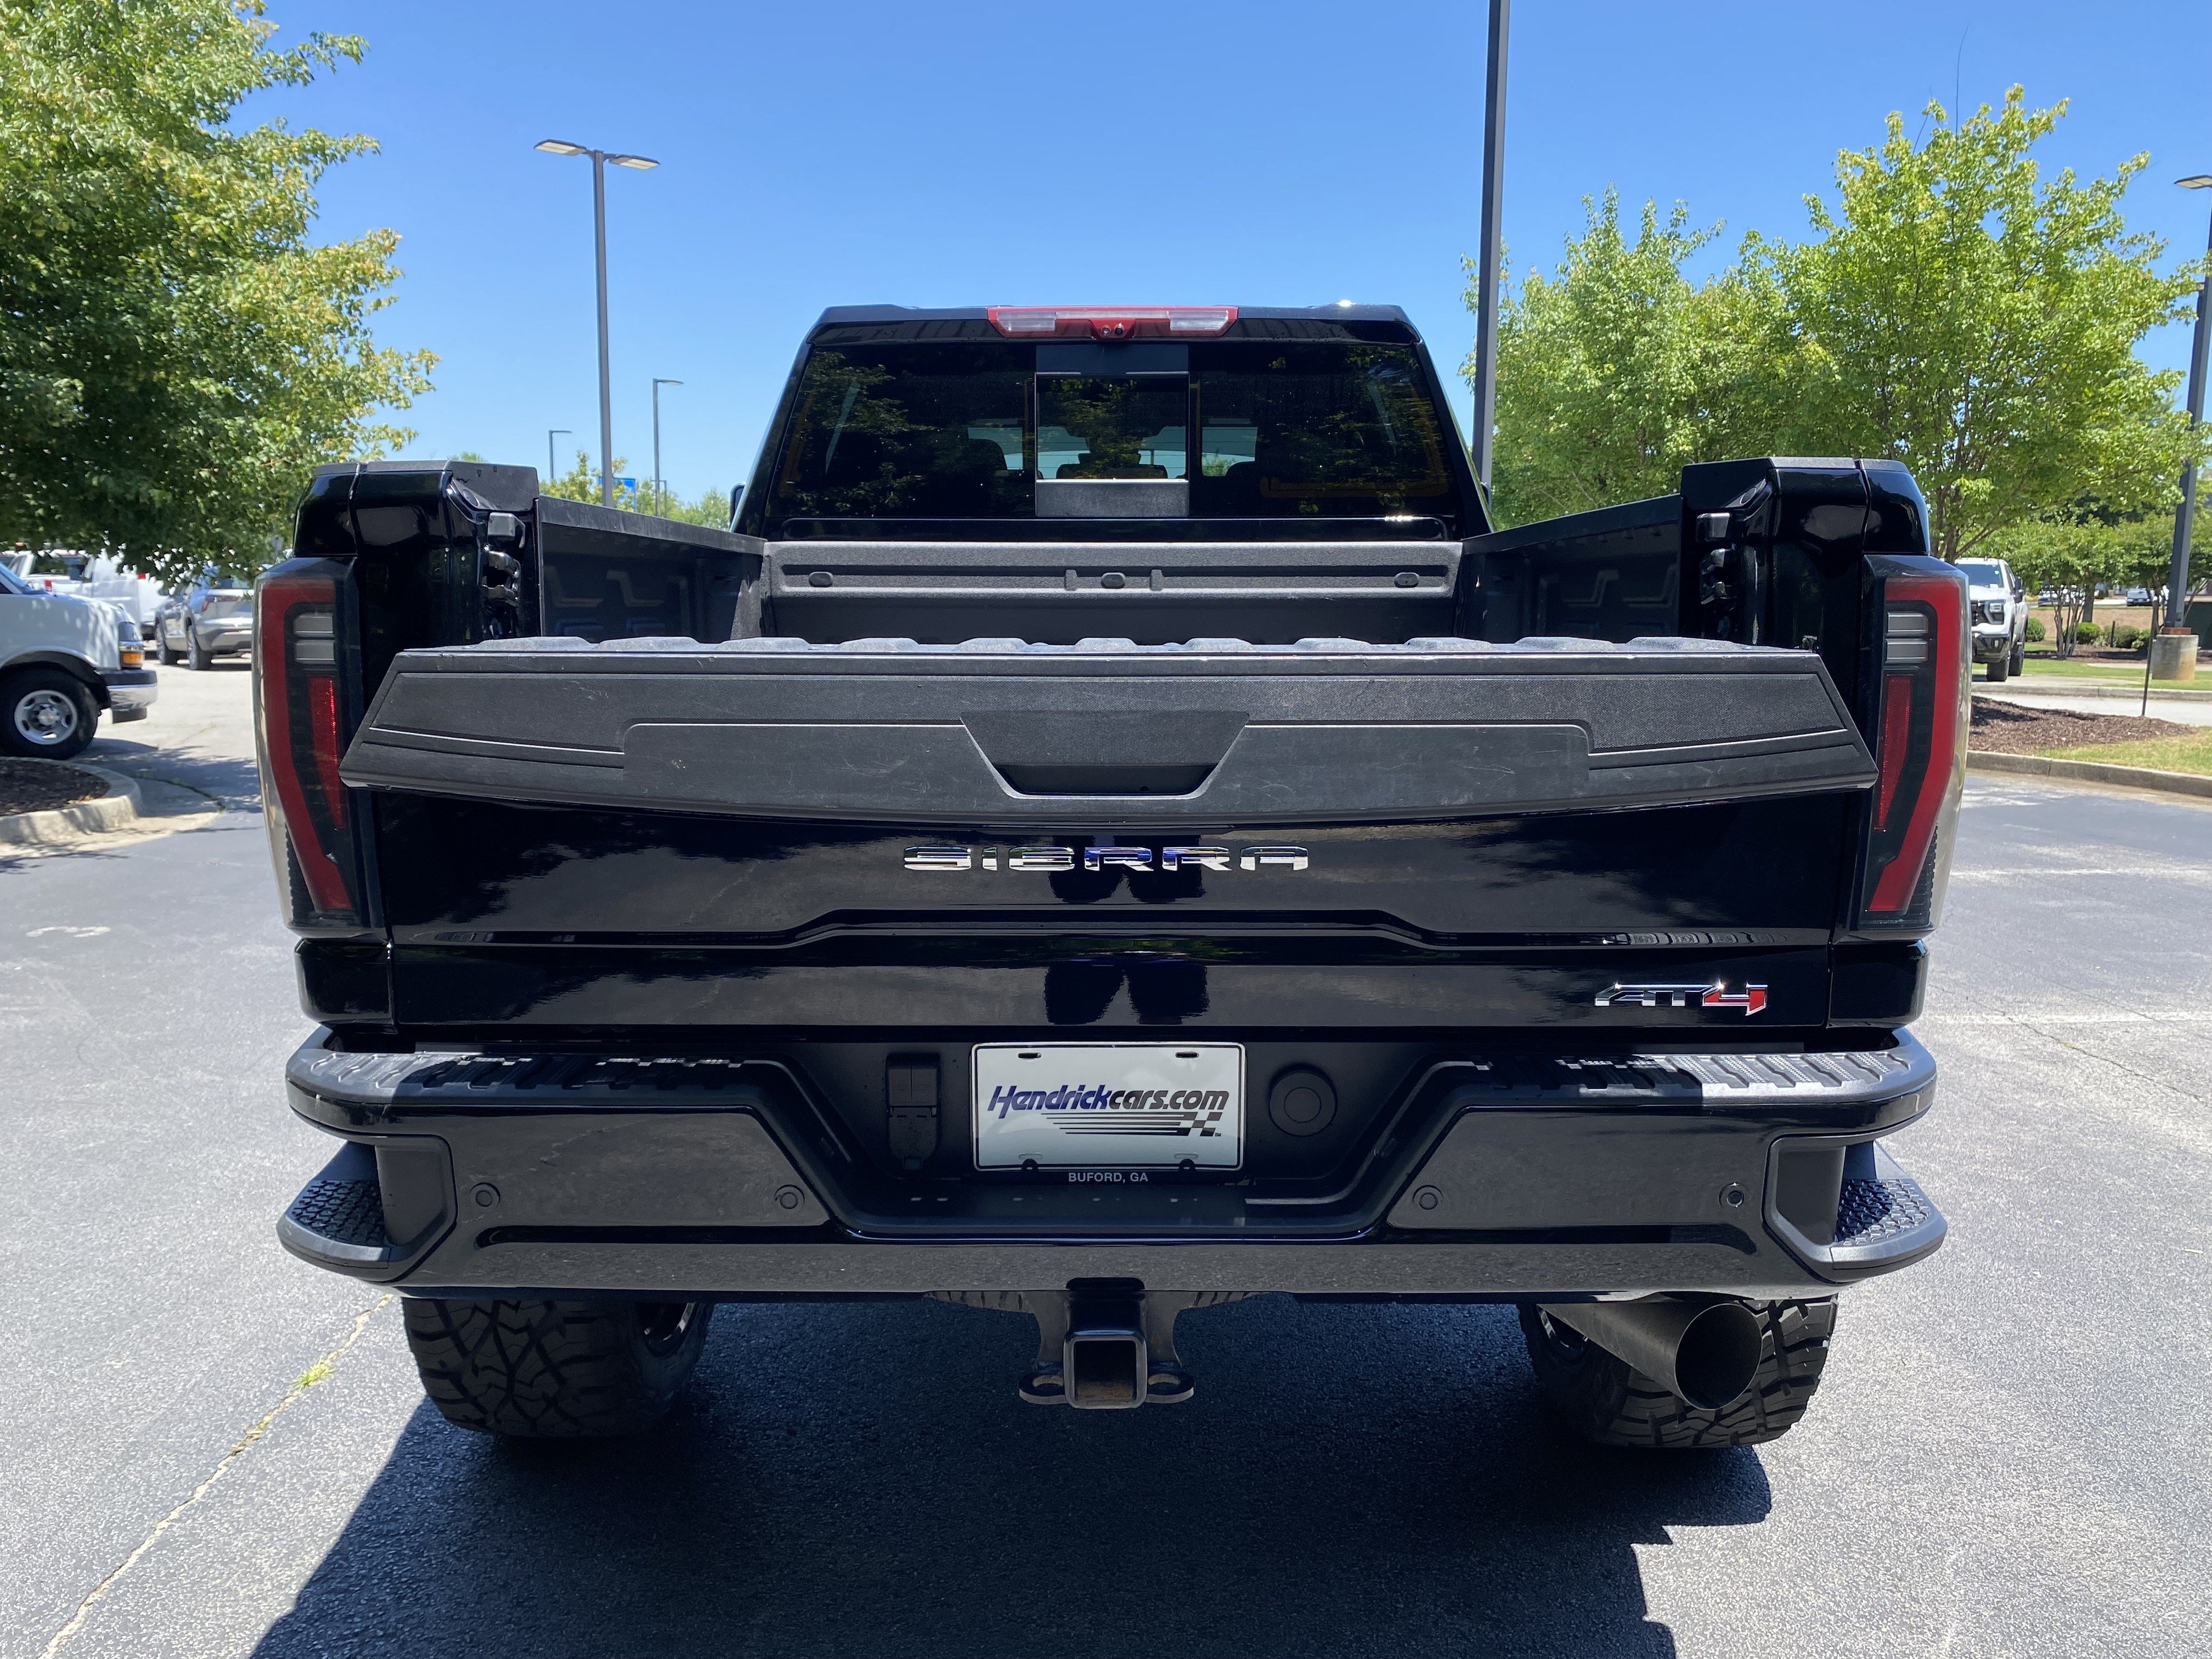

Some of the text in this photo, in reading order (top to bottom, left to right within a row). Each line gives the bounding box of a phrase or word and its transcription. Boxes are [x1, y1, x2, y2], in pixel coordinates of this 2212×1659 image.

[904, 846, 1308, 871] SIERRA
[1594, 984, 1768, 1016] AT4
[987, 1084, 1229, 1119] Hendrickcars.com
[1068, 1172, 1149, 1184] BUFORD, GA
